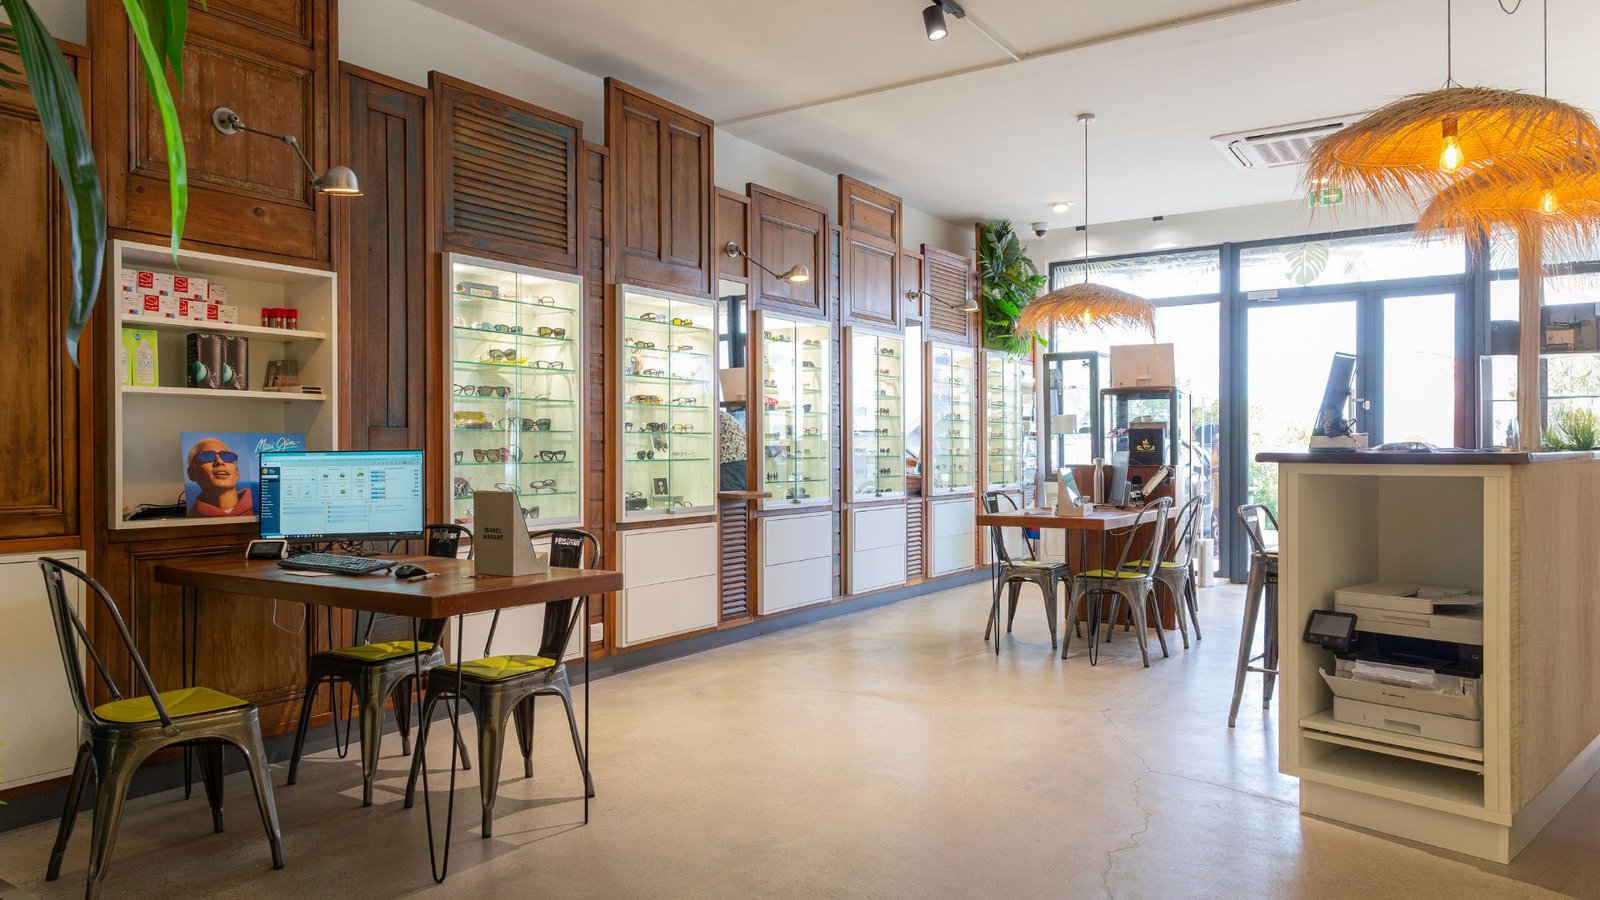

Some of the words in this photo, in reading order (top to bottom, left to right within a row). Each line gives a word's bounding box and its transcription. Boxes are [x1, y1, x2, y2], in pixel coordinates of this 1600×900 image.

[139, 272, 153, 284] Si
[175, 277, 187, 288] Si
[145, 295, 158, 306] Si
[137, 350, 153, 359] Bio
[276, 437, 301, 452] Jim
